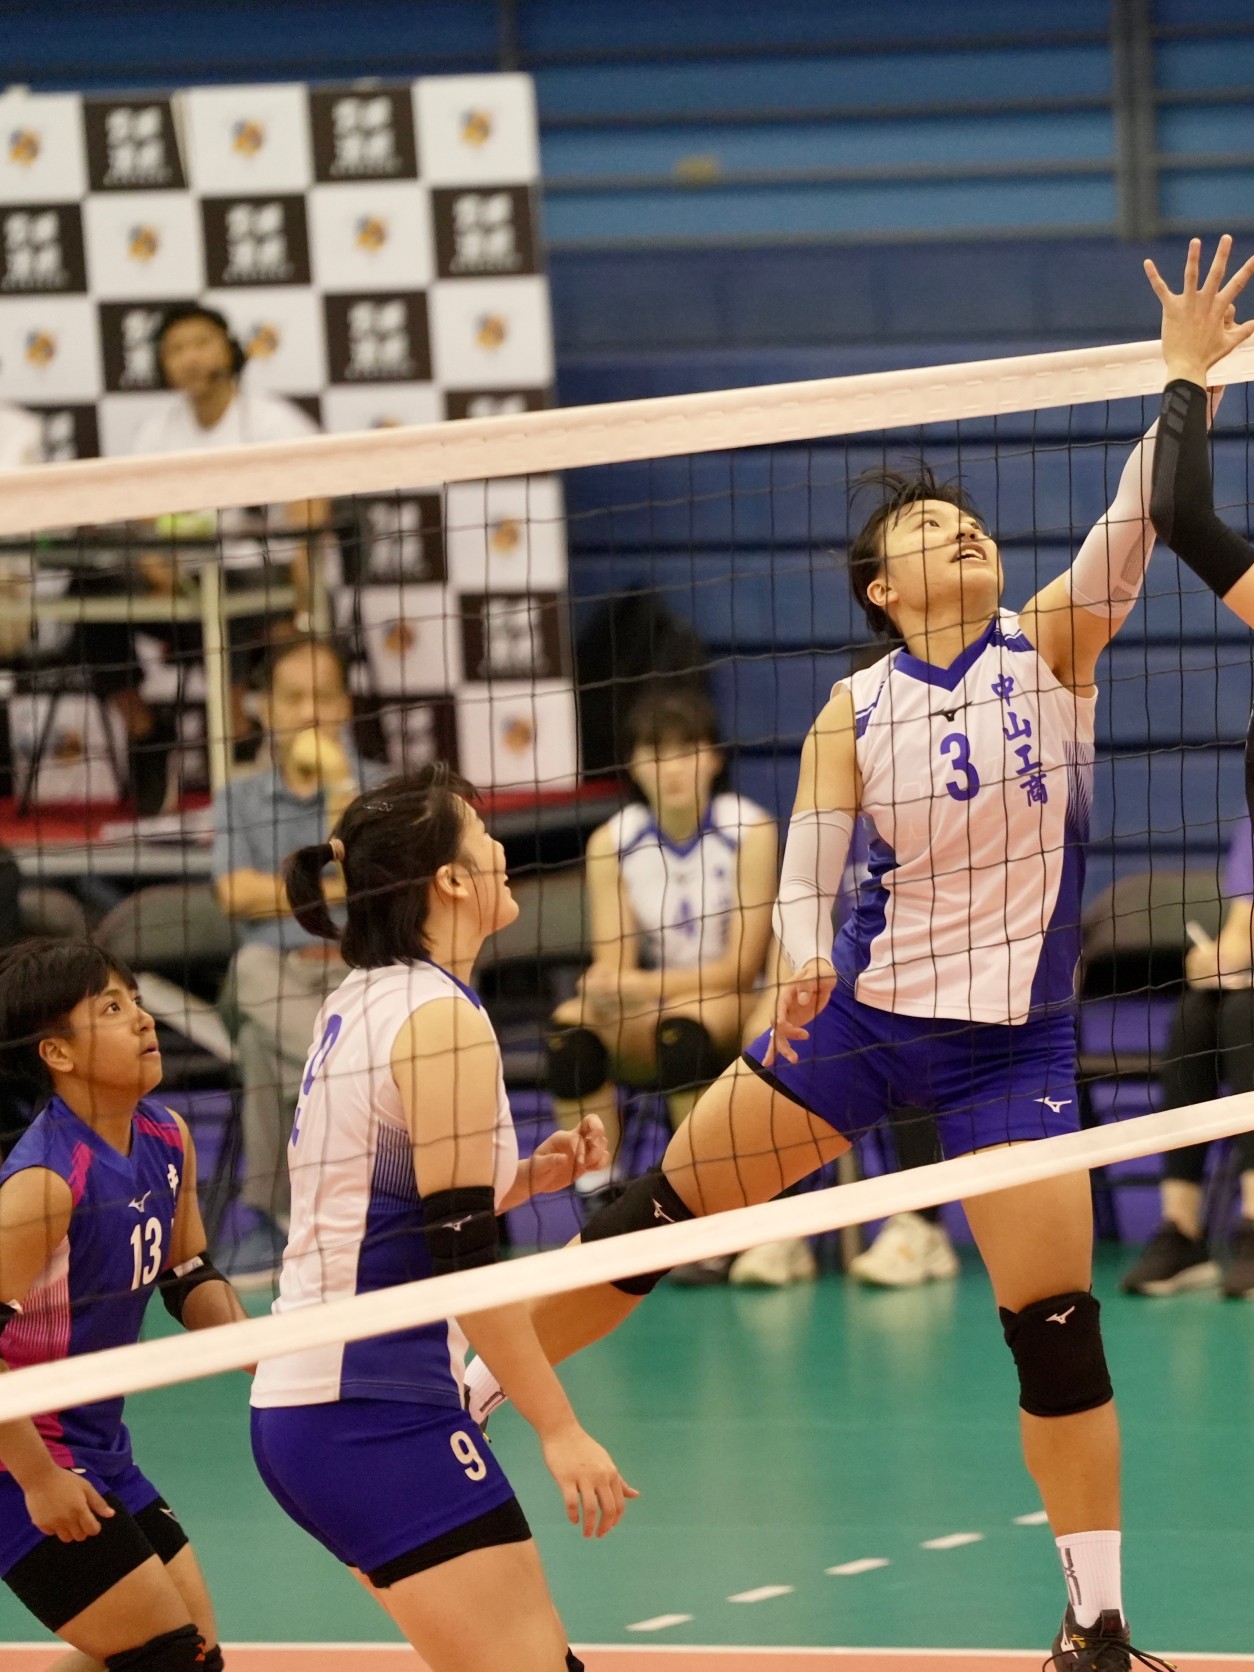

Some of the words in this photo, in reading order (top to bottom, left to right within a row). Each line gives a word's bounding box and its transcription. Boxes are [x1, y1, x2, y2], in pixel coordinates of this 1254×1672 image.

[940, 733, 980, 801] 3
[991, 674, 1048, 807] 中山工商
[130, 1217, 163, 1291] 13
[450, 1430, 487, 1482] 9
